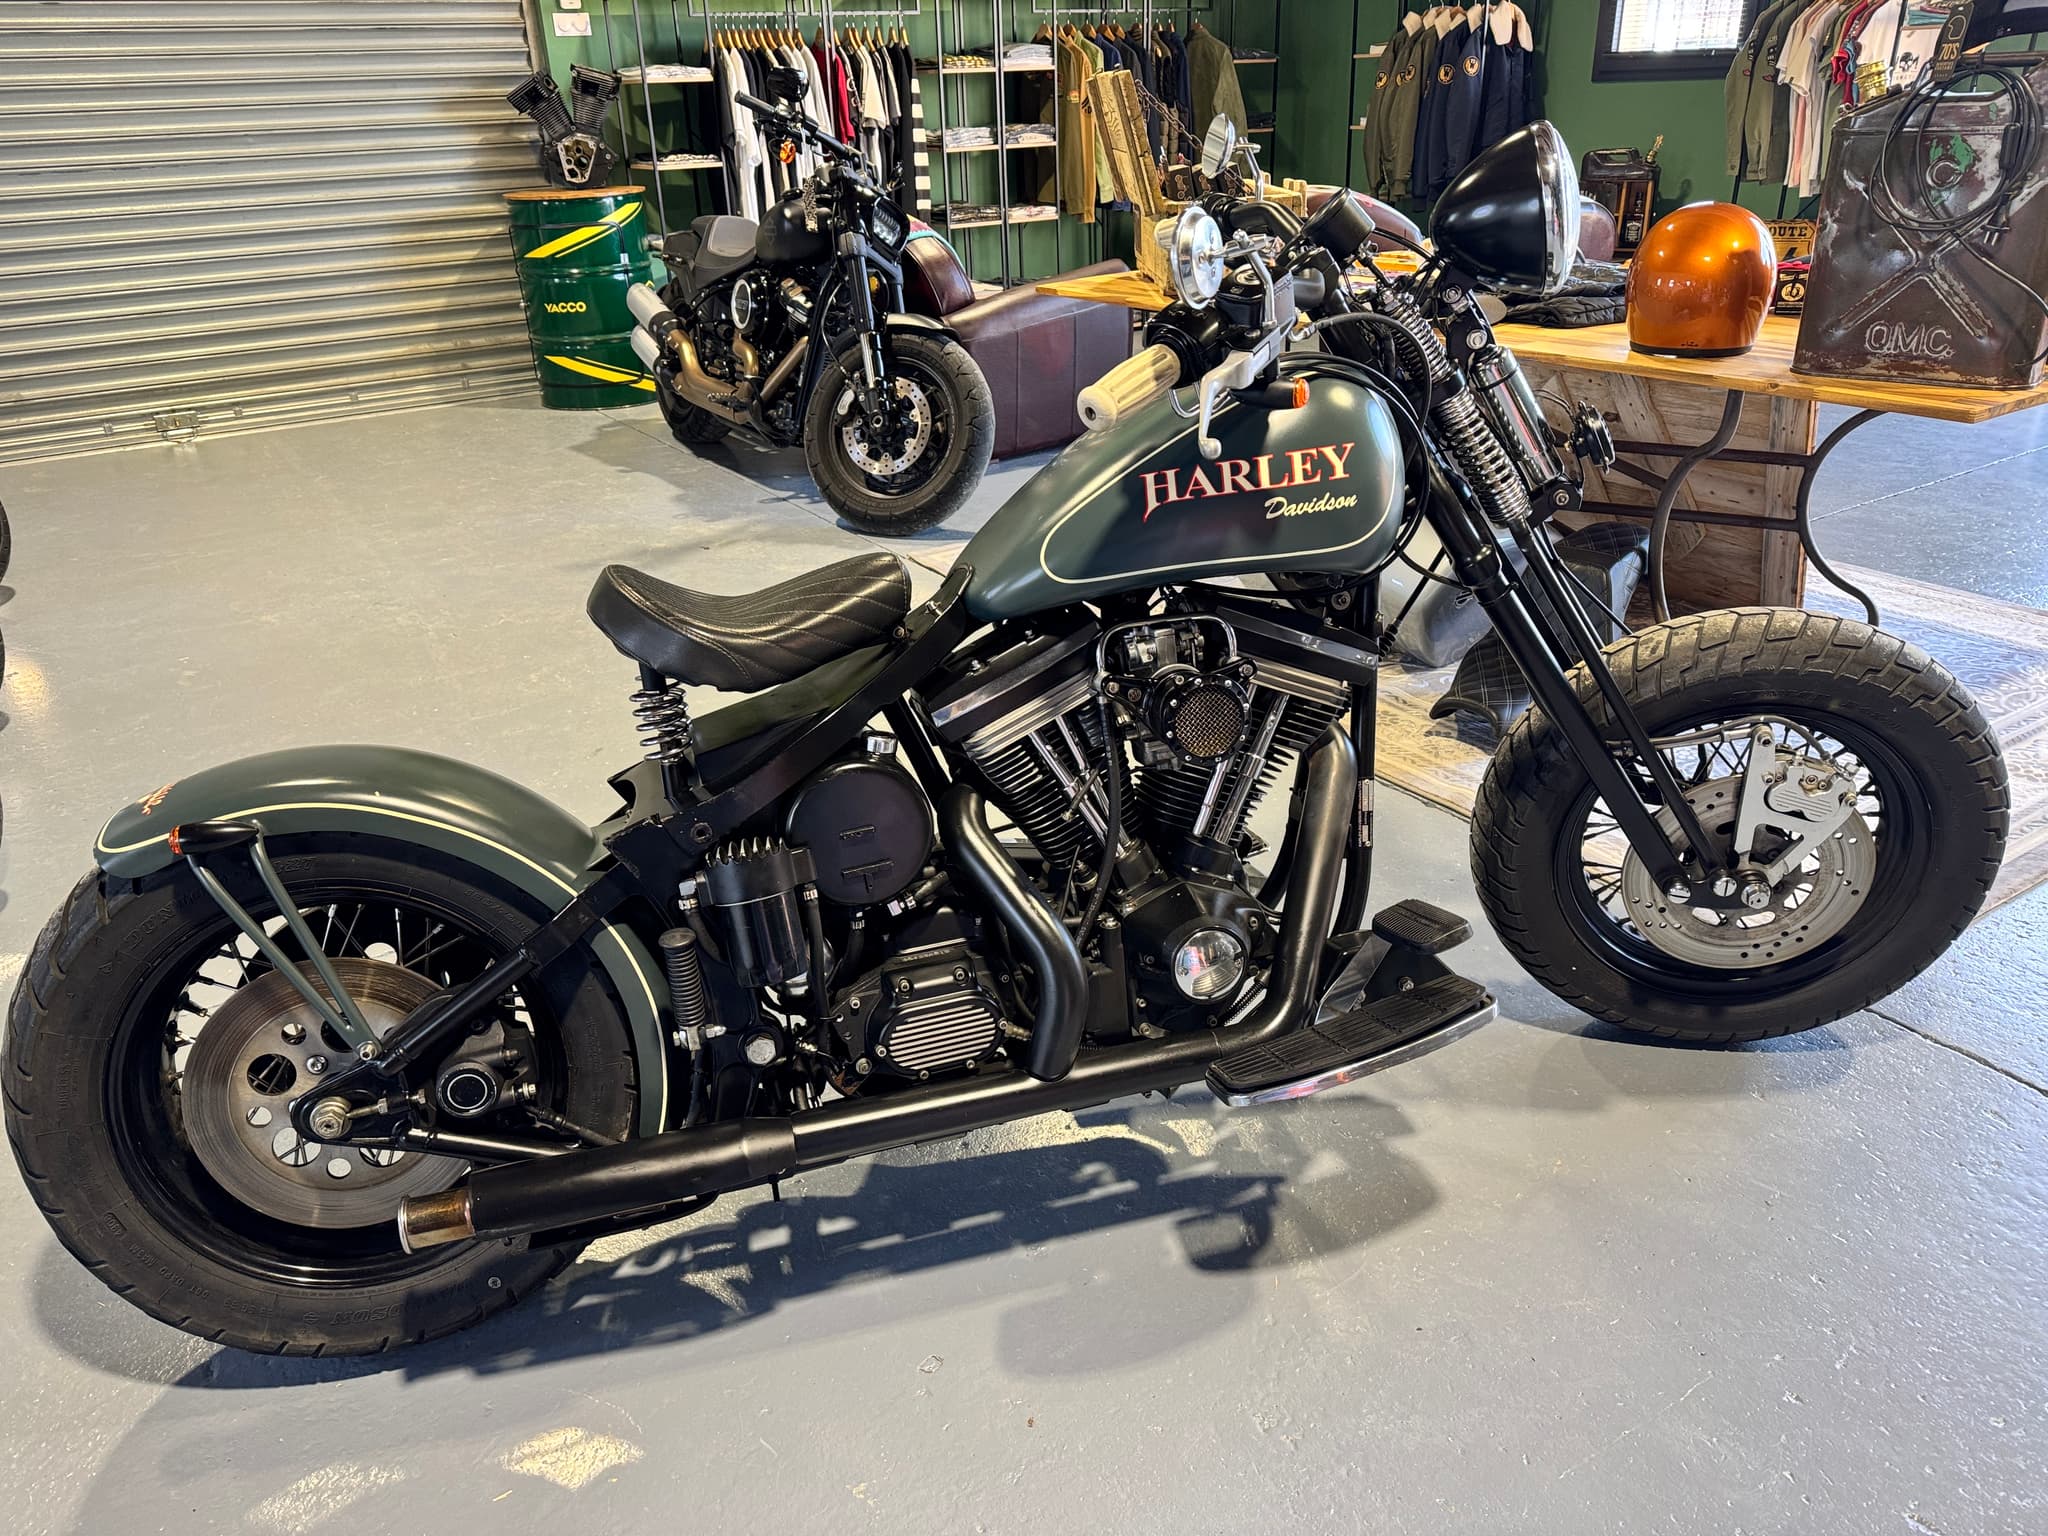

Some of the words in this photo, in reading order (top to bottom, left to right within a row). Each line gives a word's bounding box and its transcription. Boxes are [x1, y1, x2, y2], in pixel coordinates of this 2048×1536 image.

[1768, 226, 1808, 237] OUTE
[544, 301, 587, 313] YACCO
[1138, 442, 1355, 523] HARLEY
[1264, 491, 1358, 520] Davidson
